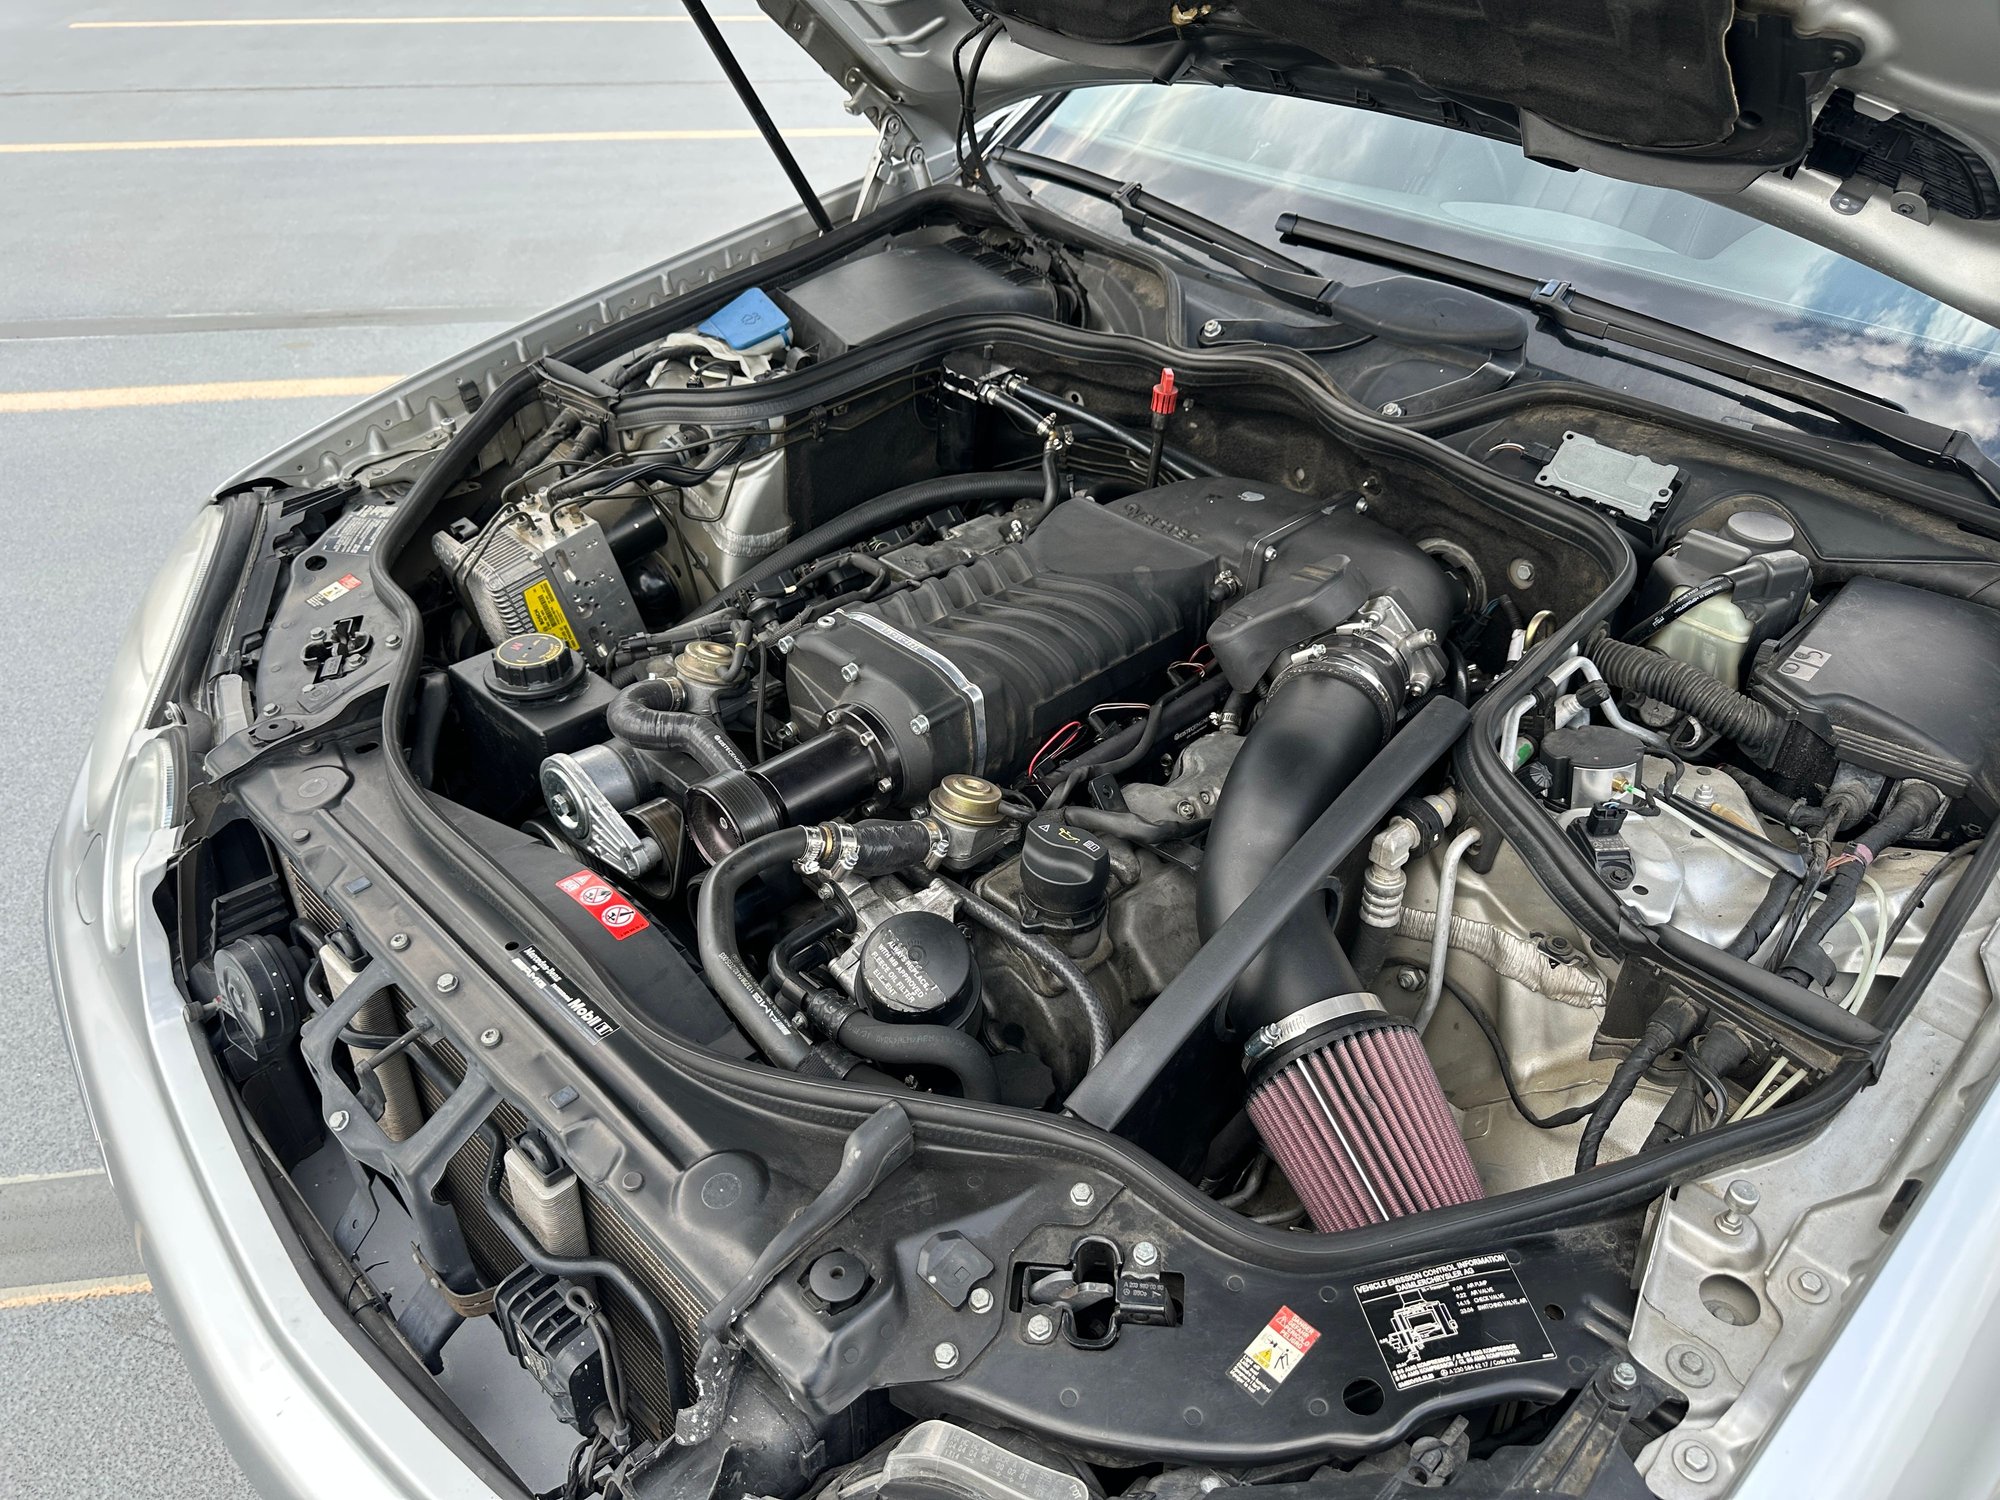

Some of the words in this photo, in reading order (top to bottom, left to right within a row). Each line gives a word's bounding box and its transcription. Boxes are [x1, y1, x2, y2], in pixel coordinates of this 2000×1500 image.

[887, 940, 906, 961] ALWAYS
[524, 947, 562, 982] Mercedes-Benz
[878, 944, 890, 957] WITH
[888, 957, 897, 966] MB
[896, 966, 923, 997] APPROVED
[871, 952, 889, 972] FLEECE
[888, 971, 898, 982] OIL
[896, 982, 914, 1002] FILTER
[568, 998, 603, 1027] Mobil
[1356, 1280, 1387, 1293] VEHICLE
[1387, 1272, 1421, 1285] EMISSION
[1423, 1264, 1456, 1277] CONTROL
[1457, 1253, 1504, 1269] INFORMATION
[1395, 1270, 1462, 1291] DAIMLERCHRYSLER
[1462, 1267, 1474, 1275] AG
[1489, 1292, 1504, 1300] VALVE
[1284, 1324, 1309, 1346] PERICOLO
[1288, 1320, 1308, 1338] GEFAHR
[1292, 1315, 1313, 1334] DANGER
[1280, 1329, 1302, 1348] PELIGRO
